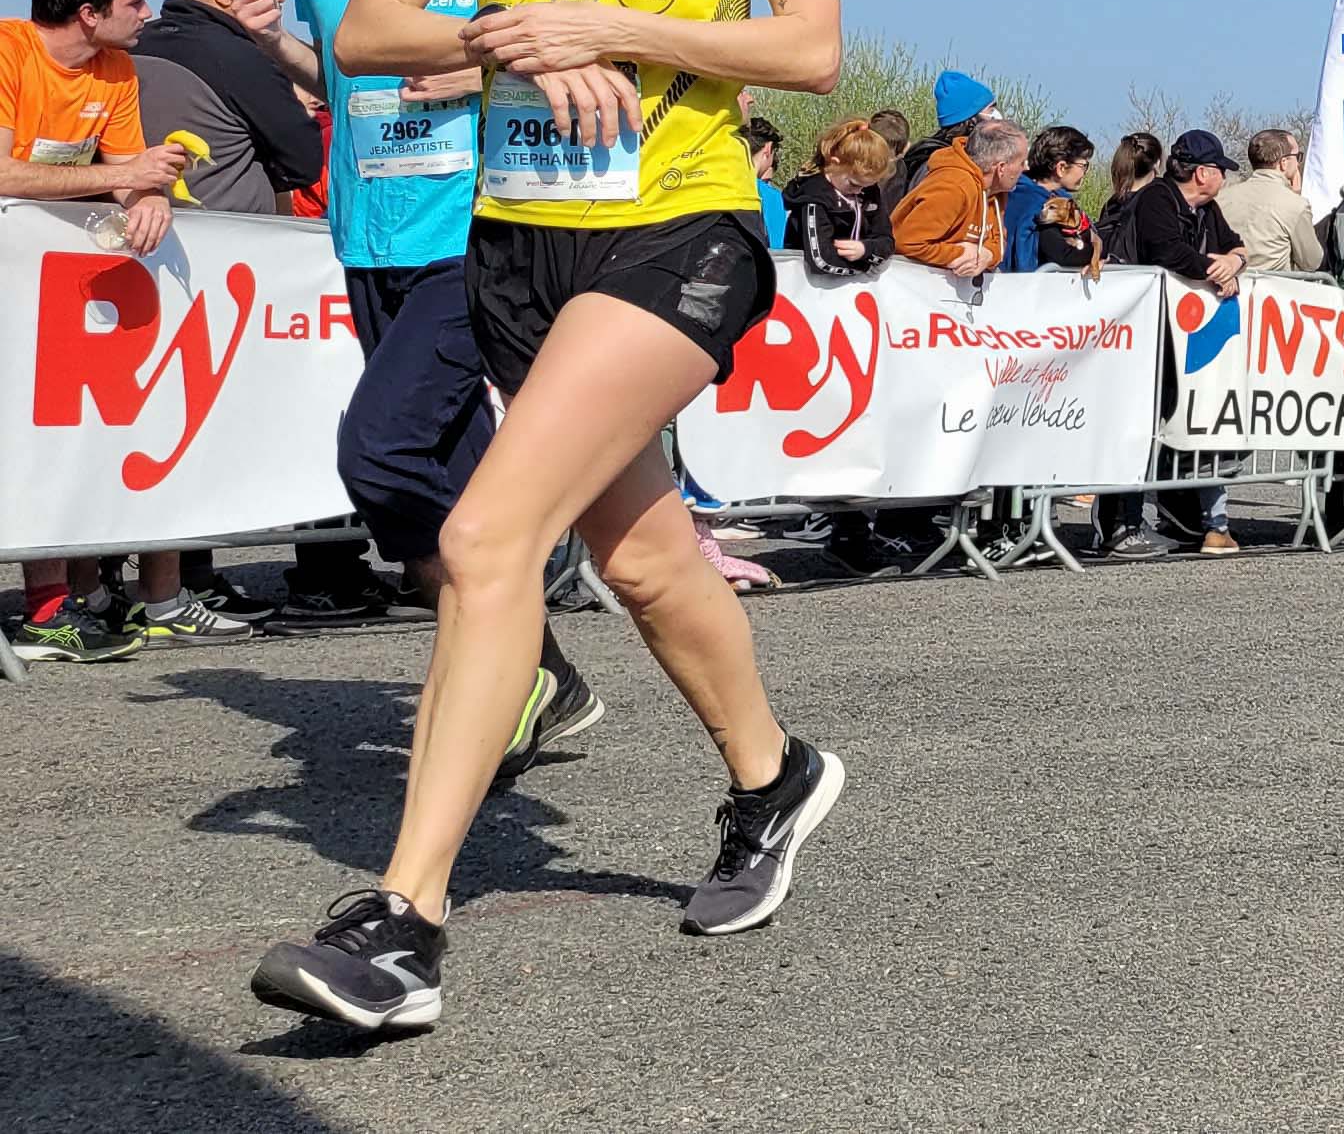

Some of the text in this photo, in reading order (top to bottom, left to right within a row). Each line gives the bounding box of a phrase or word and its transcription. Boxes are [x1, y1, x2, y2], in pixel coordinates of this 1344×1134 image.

[380, 118, 433, 142] 2962
[506, 118, 580, 147] 2961
[370, 140, 454, 155] JEAN-BAPTISTE
[504, 152, 590, 166] STEPHANIE
[264, 303, 310, 339] La
[885, 312, 1133, 351] La Roche-sur-Yon
[984, 355, 1070, 403] Ville et Agglo
[941, 402, 977, 434] Le
[1021, 391, 1086, 431] Vendée
